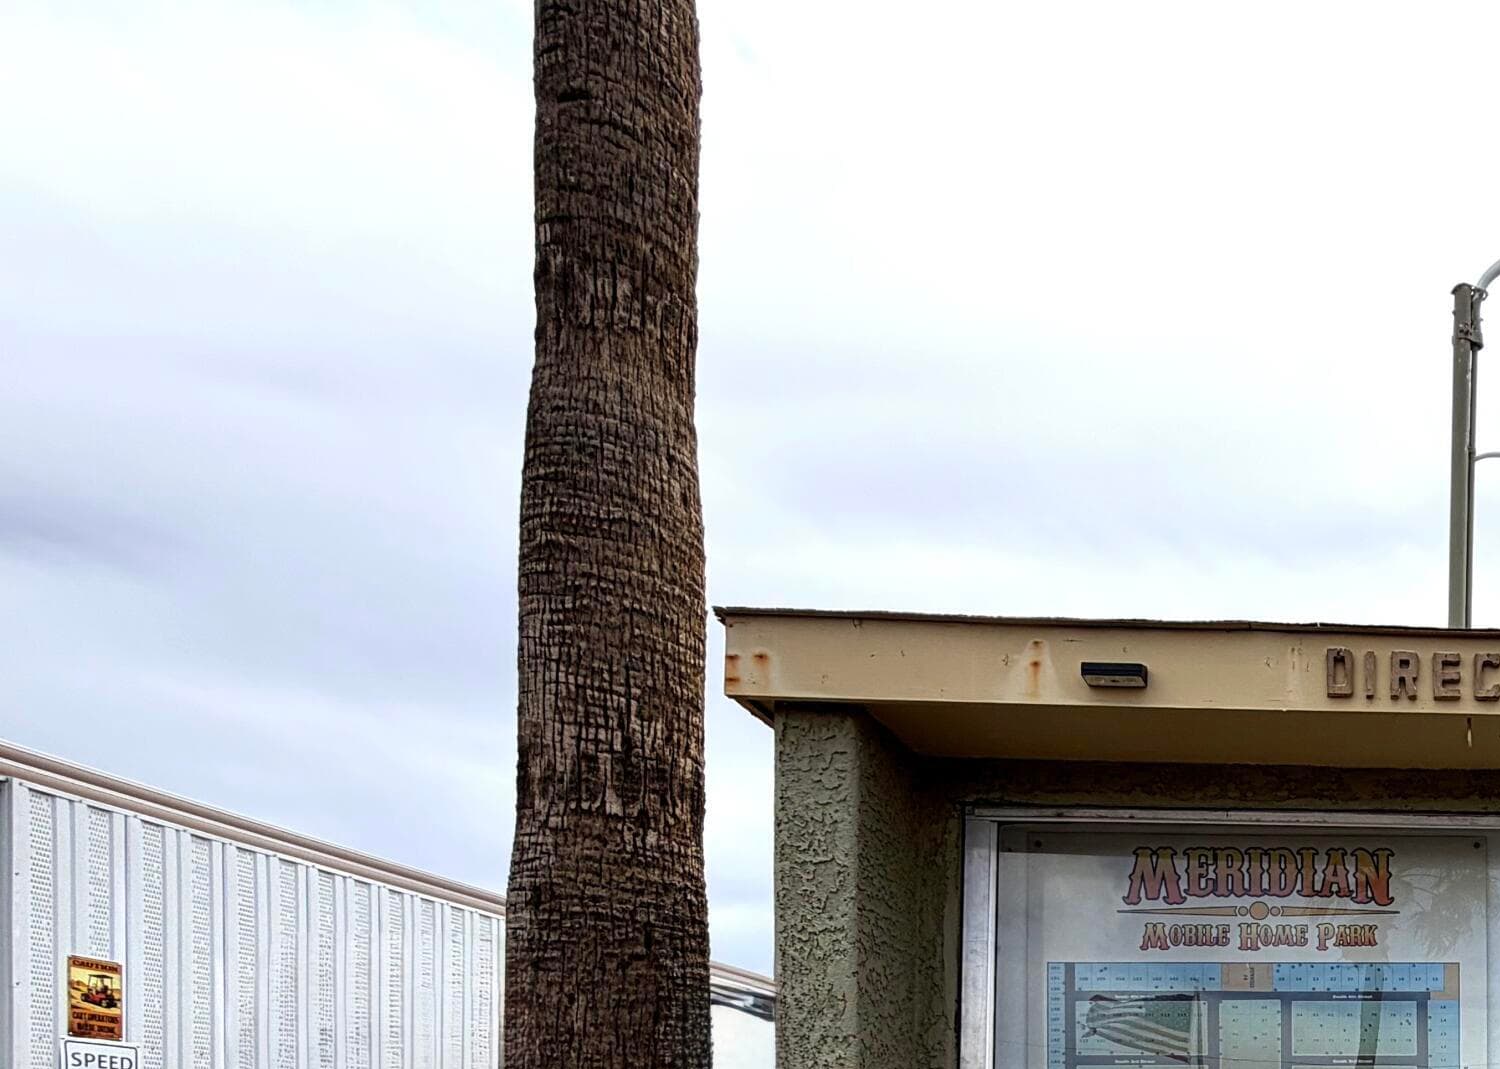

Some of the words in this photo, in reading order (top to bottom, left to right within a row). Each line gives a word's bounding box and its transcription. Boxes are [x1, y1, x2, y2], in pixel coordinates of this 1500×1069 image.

[1122, 846, 1395, 906] MERIDIAN
[1139, 922, 1231, 951] MOBILE
[1238, 922, 1309, 951] HOME
[1316, 922, 1379, 951] PARK
